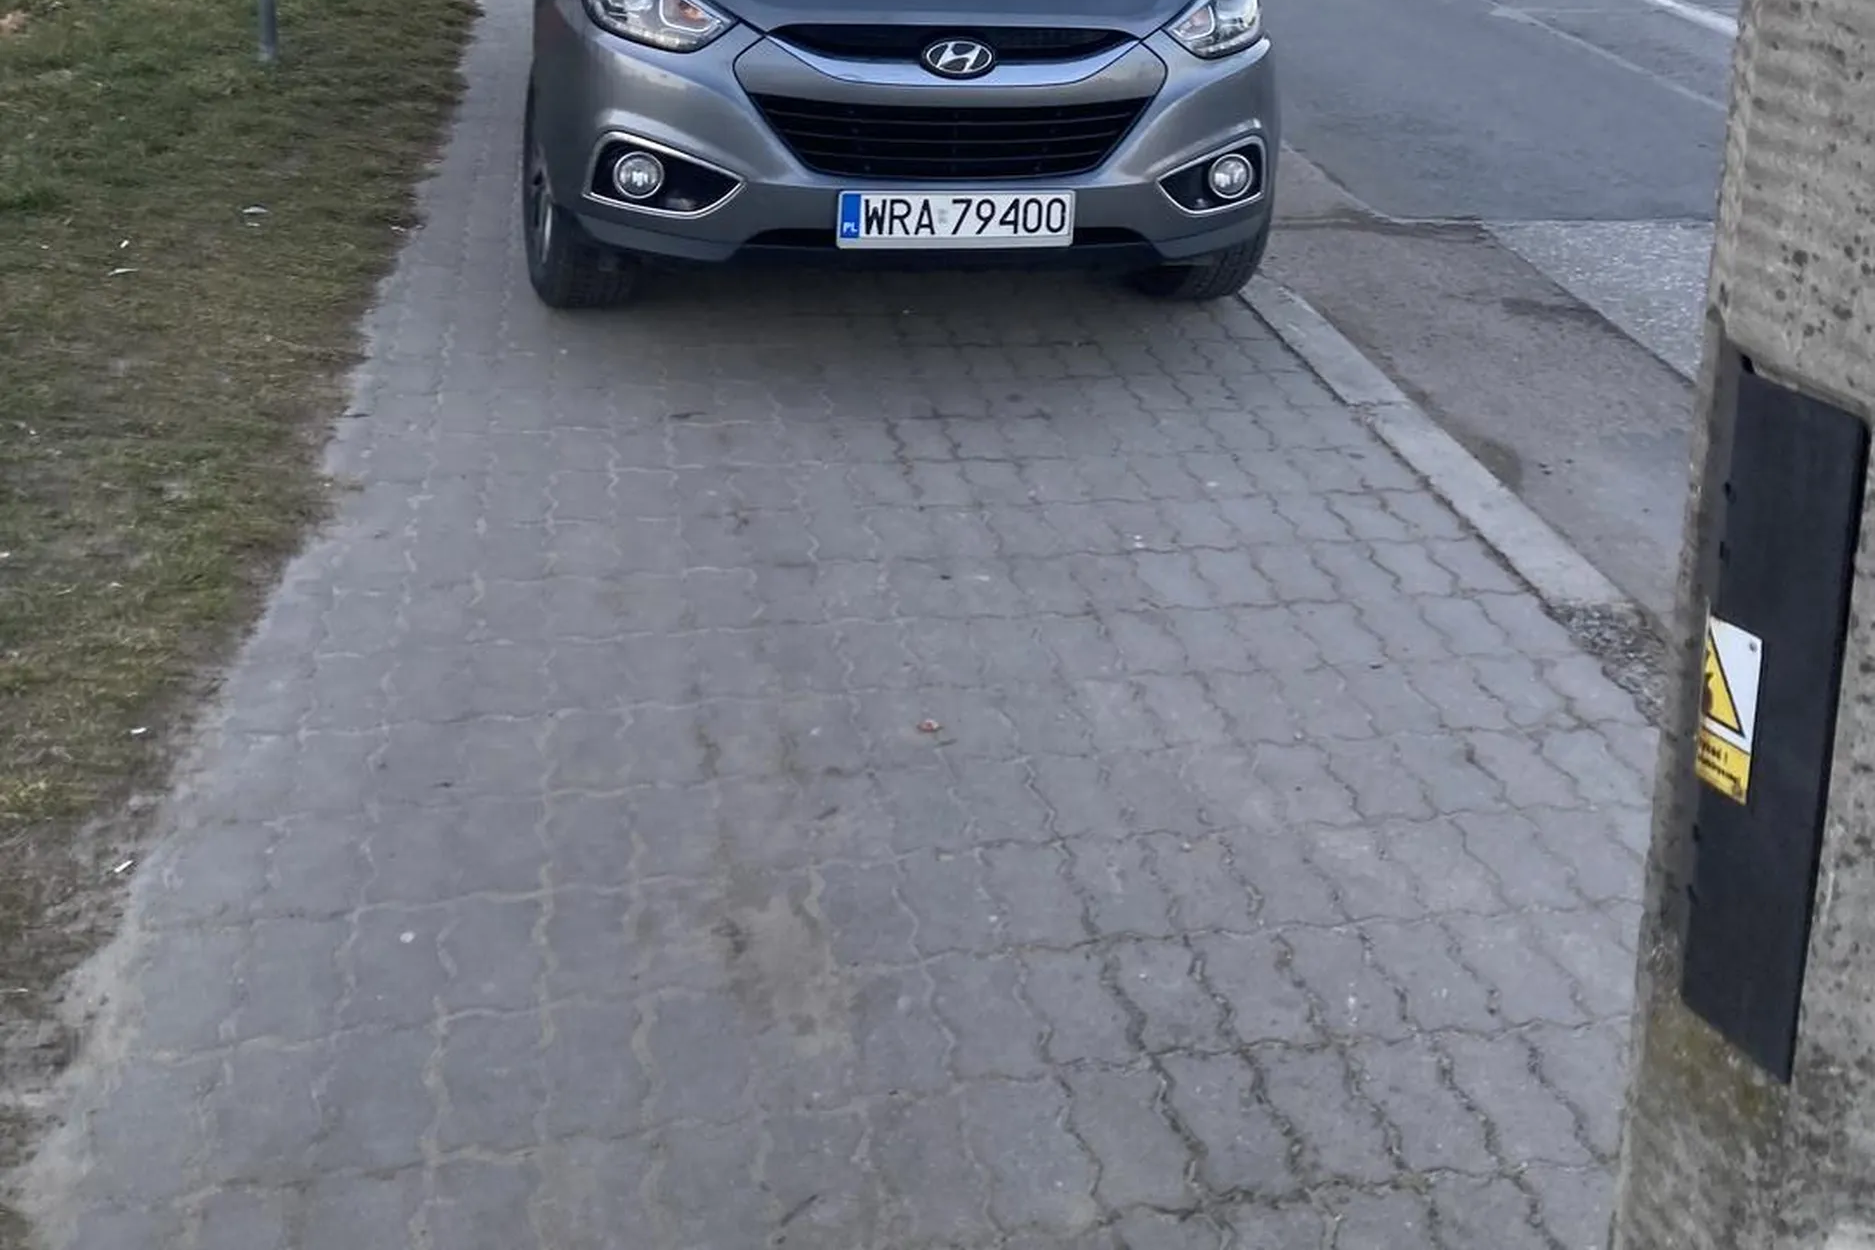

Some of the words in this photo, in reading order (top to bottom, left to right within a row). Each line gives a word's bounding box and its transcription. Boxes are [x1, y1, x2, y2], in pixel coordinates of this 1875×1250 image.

[843, 222, 858, 234] PL
[864, 199, 935, 235] WRA
[951, 198, 1066, 235] 79400
